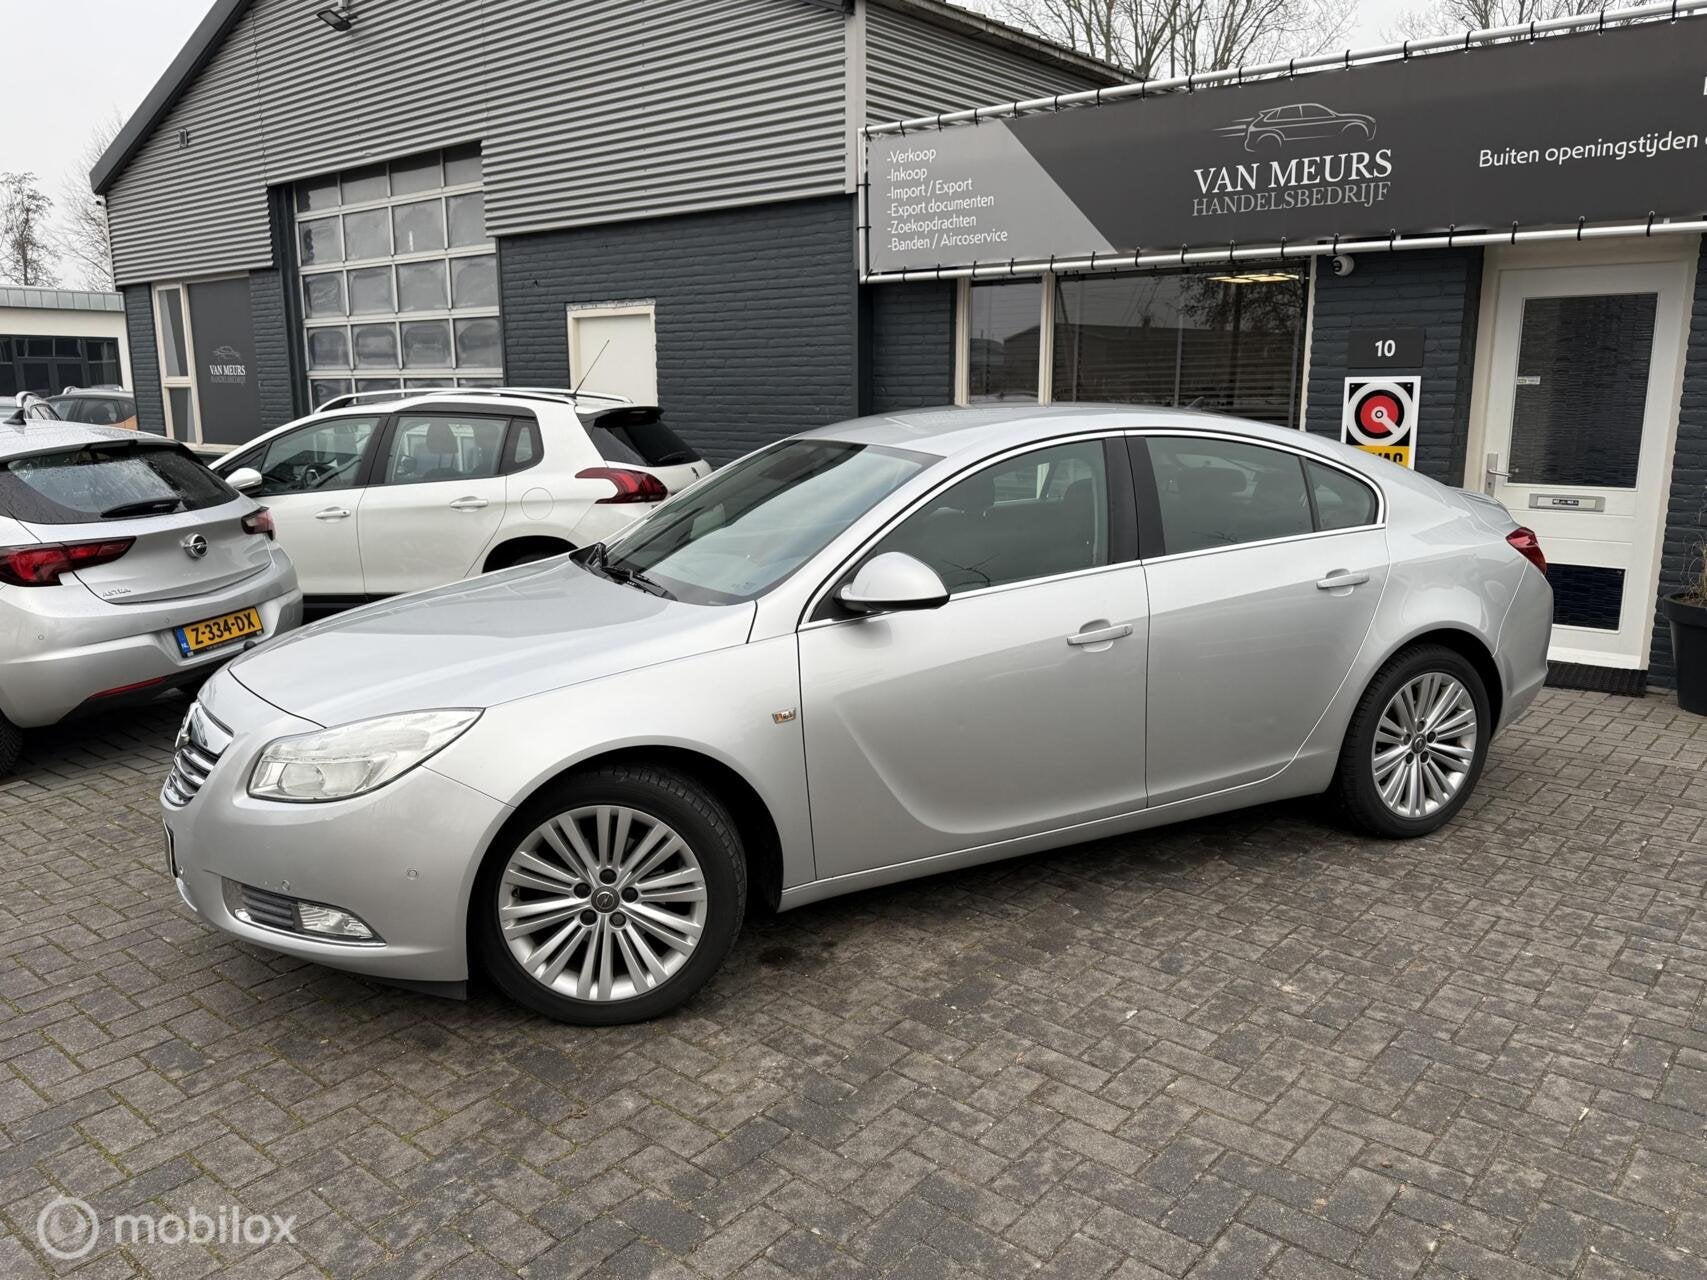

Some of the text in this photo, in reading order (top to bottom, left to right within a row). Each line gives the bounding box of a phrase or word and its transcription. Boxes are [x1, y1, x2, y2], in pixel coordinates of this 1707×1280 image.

[887, 148, 937, 164] -Verkoop
[1479, 131, 1699, 168] Buiten openingstijden
[887, 167, 928, 182] -Inkoop
[1193, 149, 1393, 194] VAN MEURS
[887, 184, 926, 200] -Import
[935, 178, 973, 196] Export
[1192, 181, 1392, 217] HANDELSBEDRIJF
[887, 193, 994, 218] -Export documenten
[887, 234, 931, 251] -Banden
[940, 230, 1008, 247] Aircoservice
[1375, 339, 1396, 357] 10
[209, 365, 246, 375] VAN MEURS
[190, 612, 256, 646] Z-334-DX
